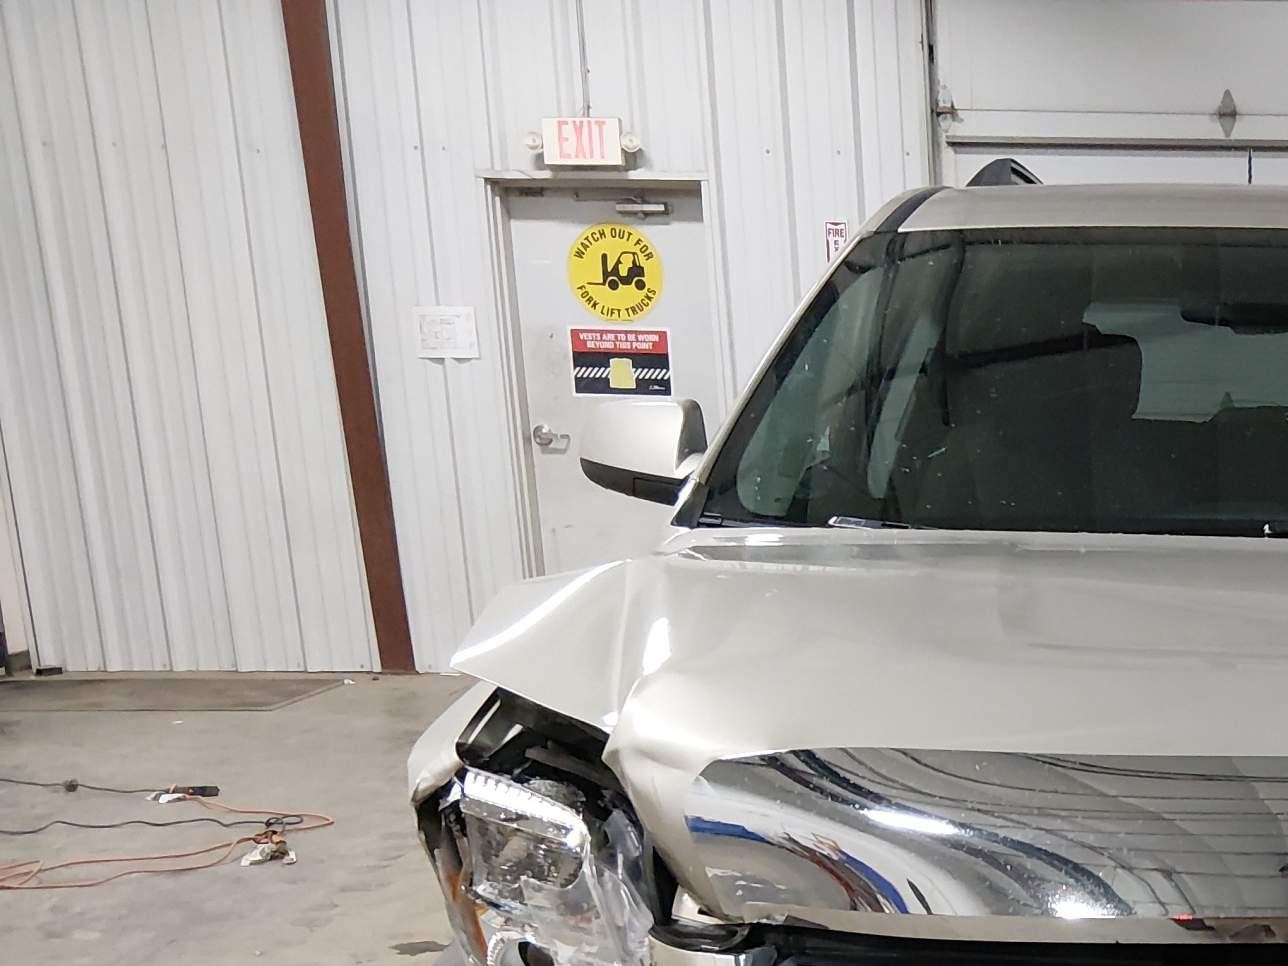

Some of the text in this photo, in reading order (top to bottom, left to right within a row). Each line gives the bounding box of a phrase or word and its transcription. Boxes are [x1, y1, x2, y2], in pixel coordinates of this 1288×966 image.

[557, 120, 606, 159] EXIT
[574, 227, 654, 261] WATCH OUT FOR
[827, 228, 845, 238] FIRE
[576, 284, 657, 319] FORK LIFT TRUCKS
[579, 332, 601, 340] VESTS
[617, 333, 626, 341] TO
[627, 333, 636, 341] BE
[637, 334, 659, 342] WORN
[586, 340, 653, 350] BEYOND THIS POINT
